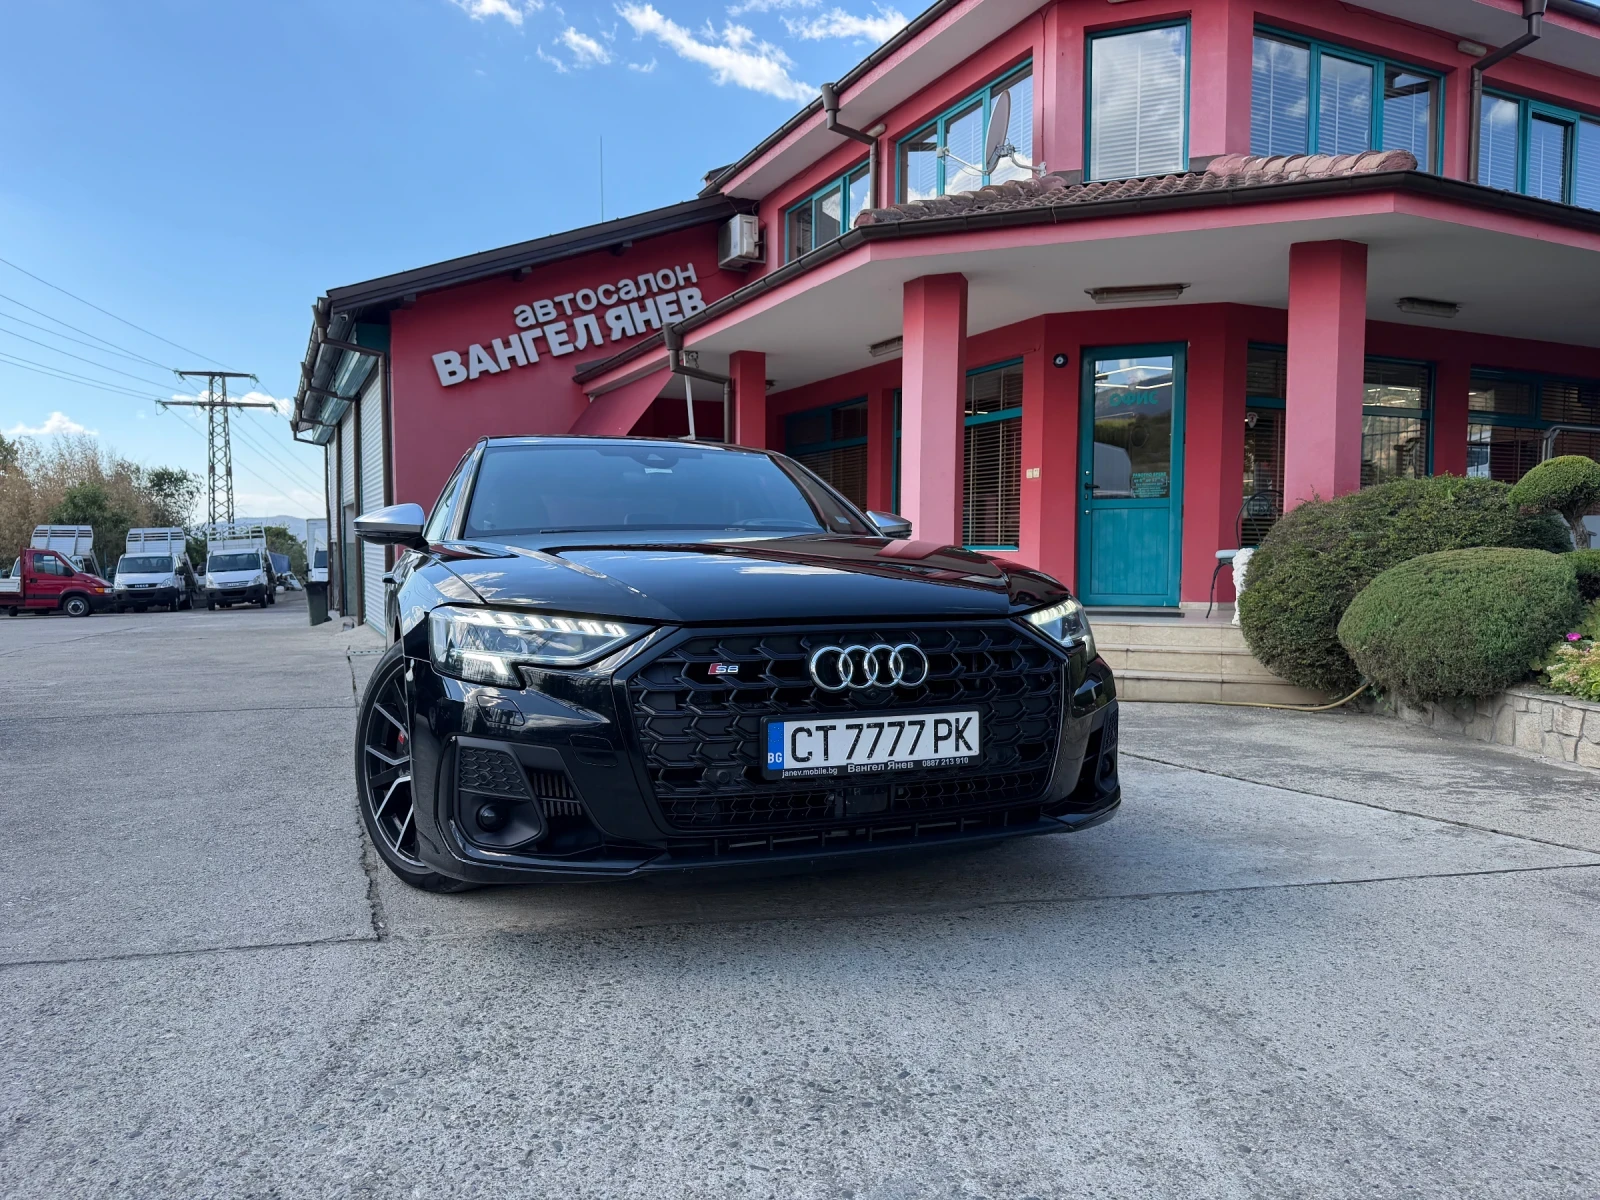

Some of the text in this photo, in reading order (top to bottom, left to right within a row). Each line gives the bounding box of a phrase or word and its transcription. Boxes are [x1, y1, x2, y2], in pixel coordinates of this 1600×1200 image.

[513, 262, 698, 328] автосалон
[431, 287, 707, 387] ВАНГЕЛ ЯНЕВ
[1109, 390, 1159, 407] ОФИС
[715, 665, 739, 673] S8
[845, 720, 926, 760] 7777
[767, 752, 783, 764] BG
[922, 757, 969, 767] 0887 213 910
[782, 767, 838, 779] janev.mobile.bg
[847, 761, 914, 773] Вангел Янев
